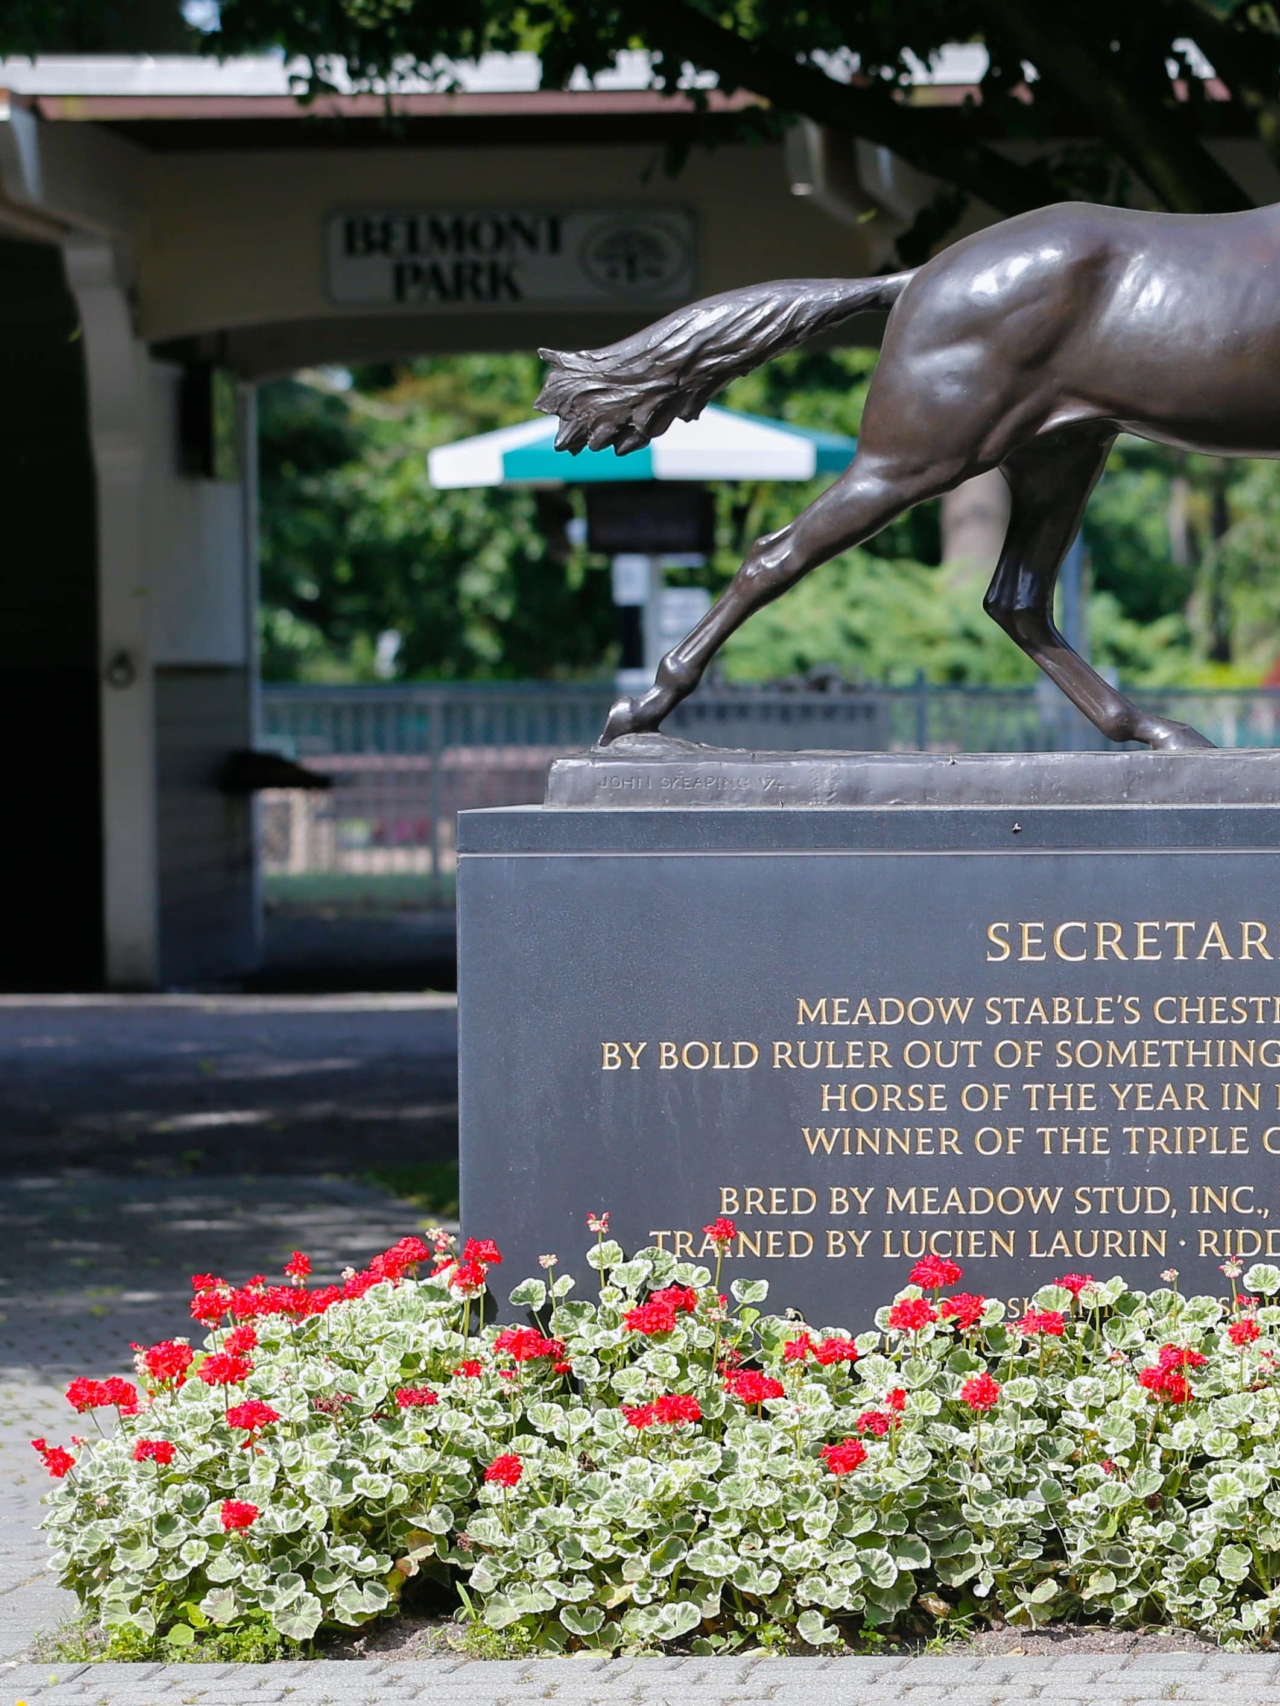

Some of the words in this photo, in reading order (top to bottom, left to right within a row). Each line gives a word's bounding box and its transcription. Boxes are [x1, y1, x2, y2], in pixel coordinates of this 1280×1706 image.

[344, 213, 563, 256] BELMONT
[393, 261, 523, 302] PARK
[599, 775, 652, 789] JOHN
[796, 996, 975, 1026] MEADOW
[984, 995, 1143, 1026] STABLE'S
[601, 1041, 648, 1070] BY
[659, 1041, 761, 1070] BOLD
[772, 1040, 893, 1069] RULER
[902, 1039, 984, 1069] OUT
[992, 1039, 1044, 1069] OF
[820, 1083, 948, 1113] HORSE
[959, 1083, 1011, 1112] OF
[1022, 1083, 1097, 1111] THE
[1108, 1082, 1210, 1111] YEAR
[1221, 1082, 1262, 1111] IN
[801, 1126, 964, 1155] WINNER
[973, 1126, 1025, 1156] OF
[1035, 1126, 1111, 1155] THE
[1122, 1125, 1250, 1155] TRIPLE
[718, 1186, 818, 1215] BRED
[829, 1186, 875, 1215] BY
[886, 1185, 1064, 1215] MEADOW
[1073, 1185, 1177, 1219] STUD,
[1189, 1185, 1269, 1219] INC.,
[825, 1229, 872, 1258] BY
[882, 1229, 1016, 1258] LUCIEN
[1028, 1229, 1168, 1258] LAURIN
